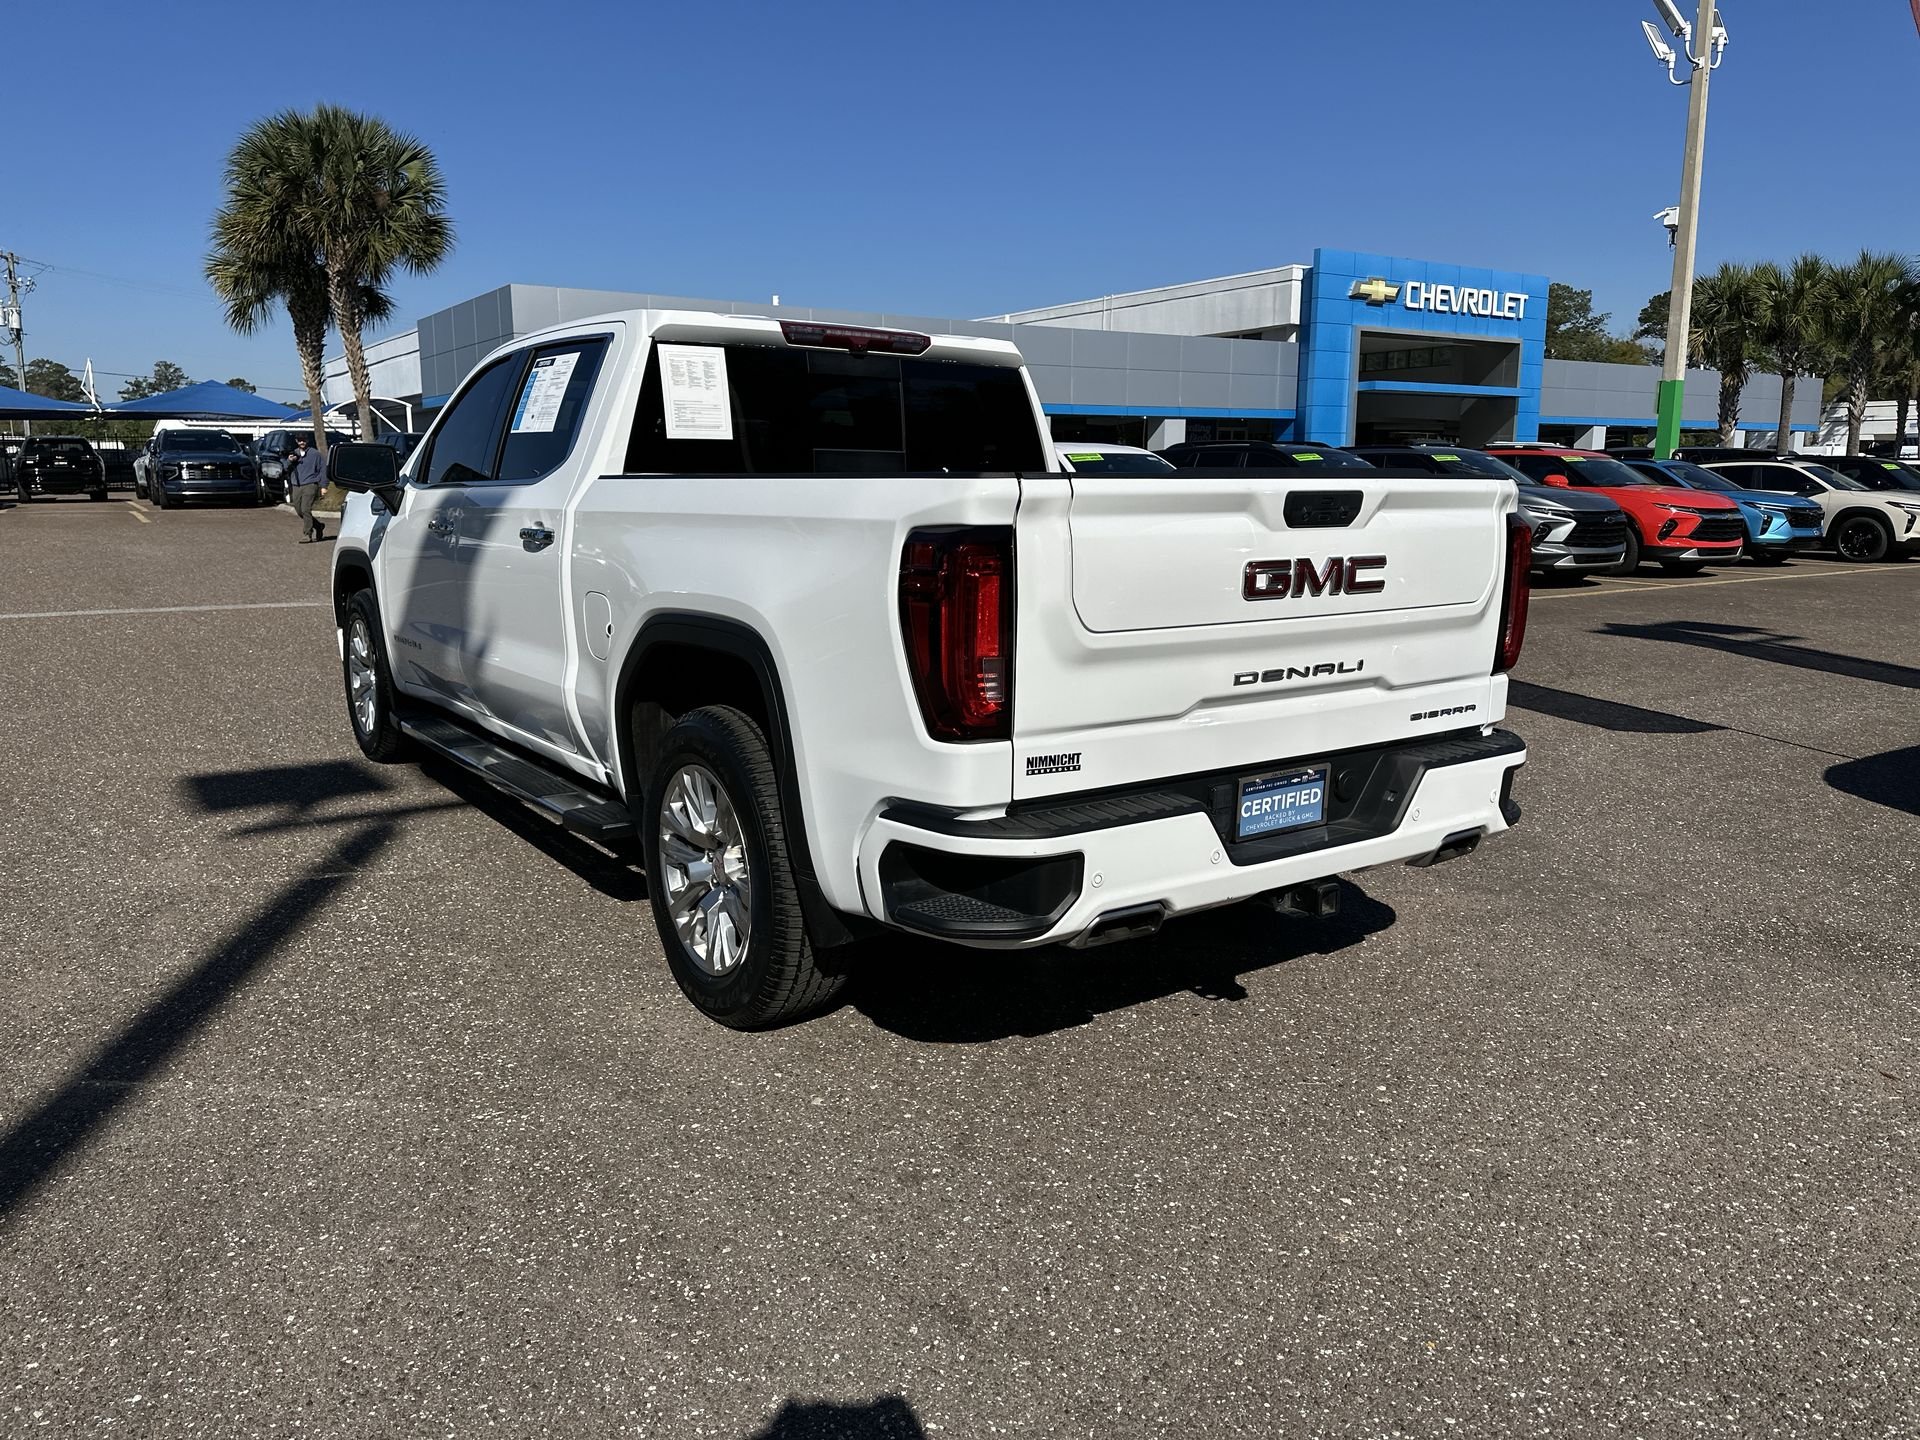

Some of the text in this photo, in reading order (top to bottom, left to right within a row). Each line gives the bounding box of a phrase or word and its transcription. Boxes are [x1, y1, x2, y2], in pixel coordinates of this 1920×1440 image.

[1405, 281, 1529, 319] CHEVROLET
[1242, 554, 1388, 602] GMC
[1233, 659, 1364, 687] DENALI
[1410, 704, 1477, 722] SIERRA
[1026, 752, 1082, 769] NIMNICHT
[1240, 787, 1321, 818] CERTIFIED
[1245, 820, 1278, 832] CHEVROLET
[1279, 816, 1296, 824] BUICK
[1264, 812, 1287, 821] BACKED
